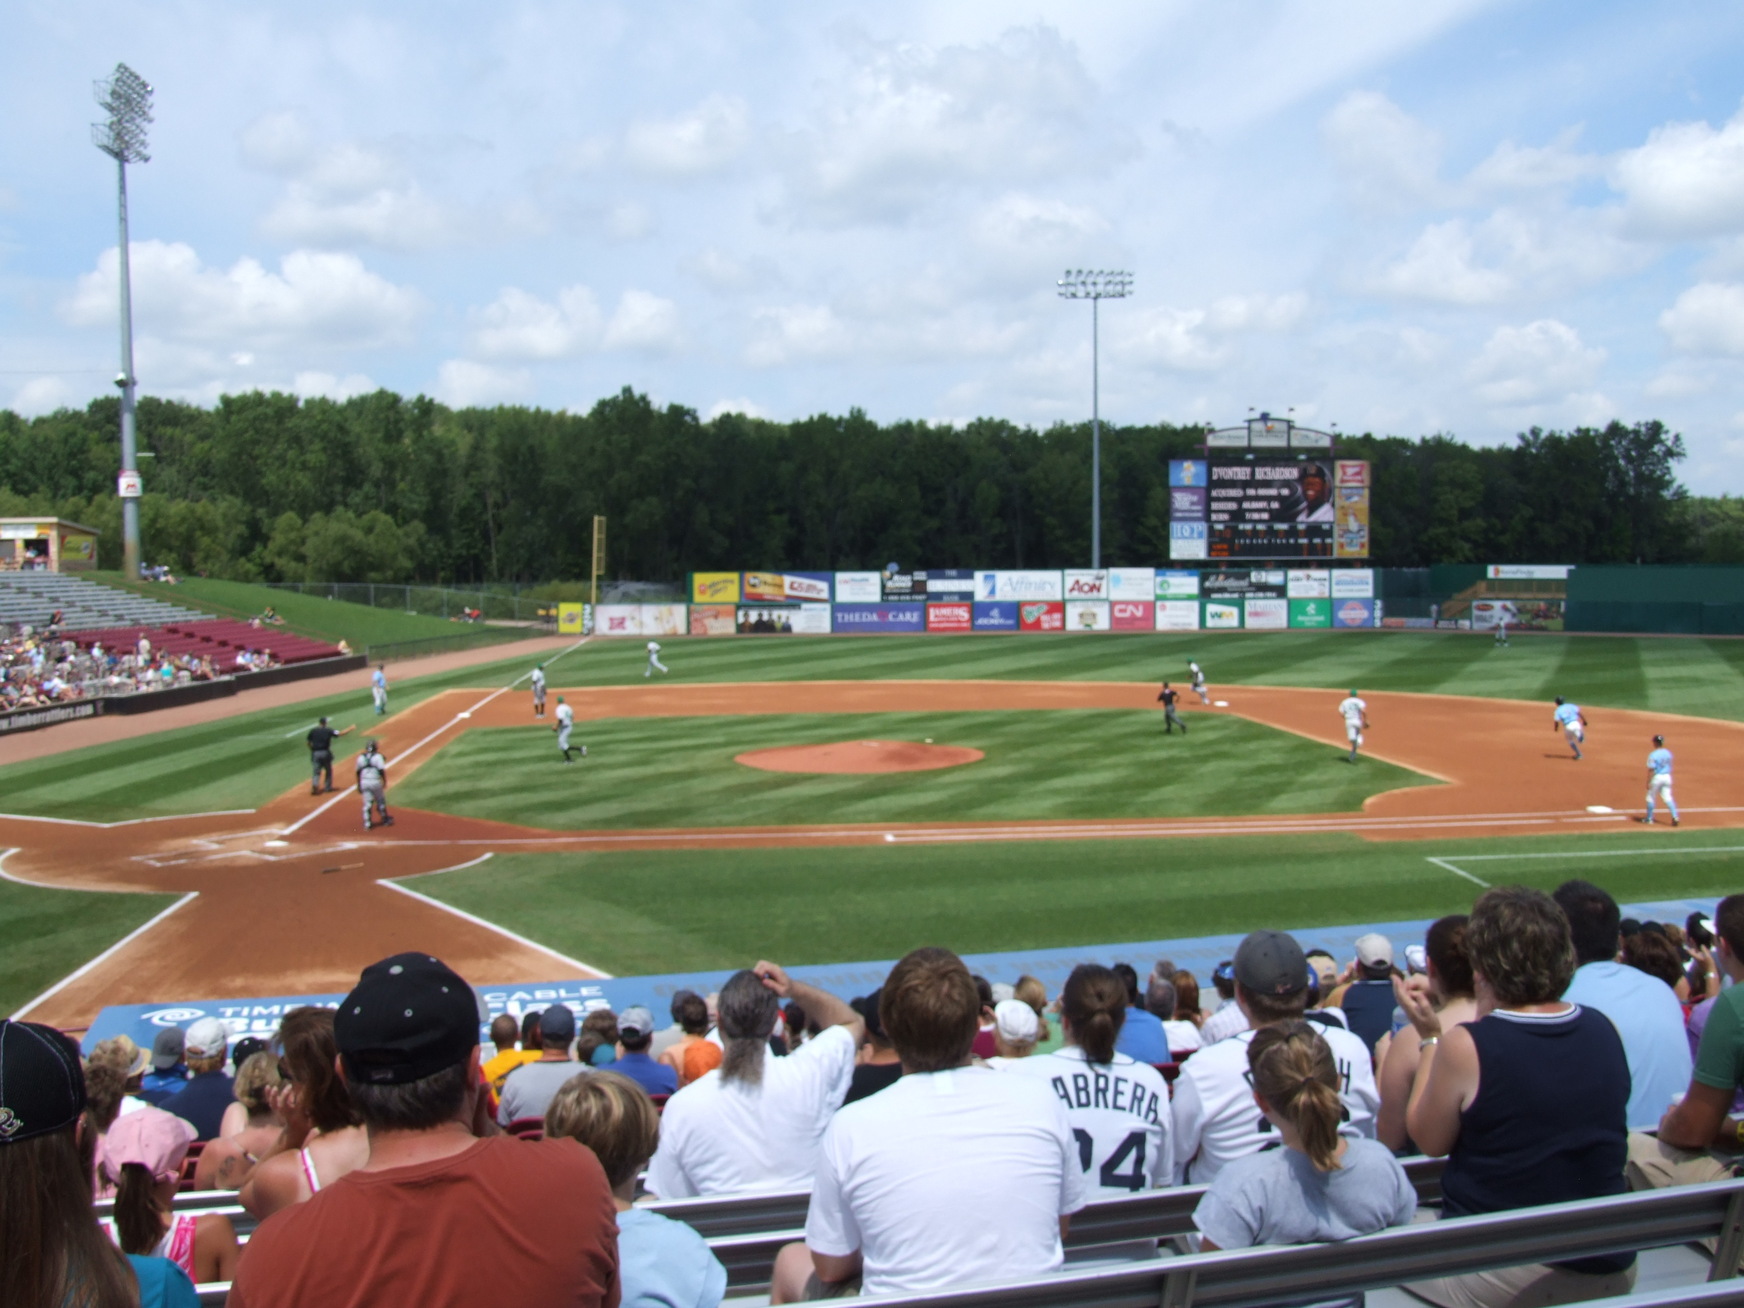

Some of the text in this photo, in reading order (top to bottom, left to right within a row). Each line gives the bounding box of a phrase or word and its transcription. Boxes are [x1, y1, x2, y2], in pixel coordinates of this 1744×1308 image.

[1255, 467, 1299, 480] RICHARDSON
[1114, 604, 1143, 618] CN
[484, 986, 603, 1002] CABLE
[1051, 1073, 1159, 1125] ABRERA
